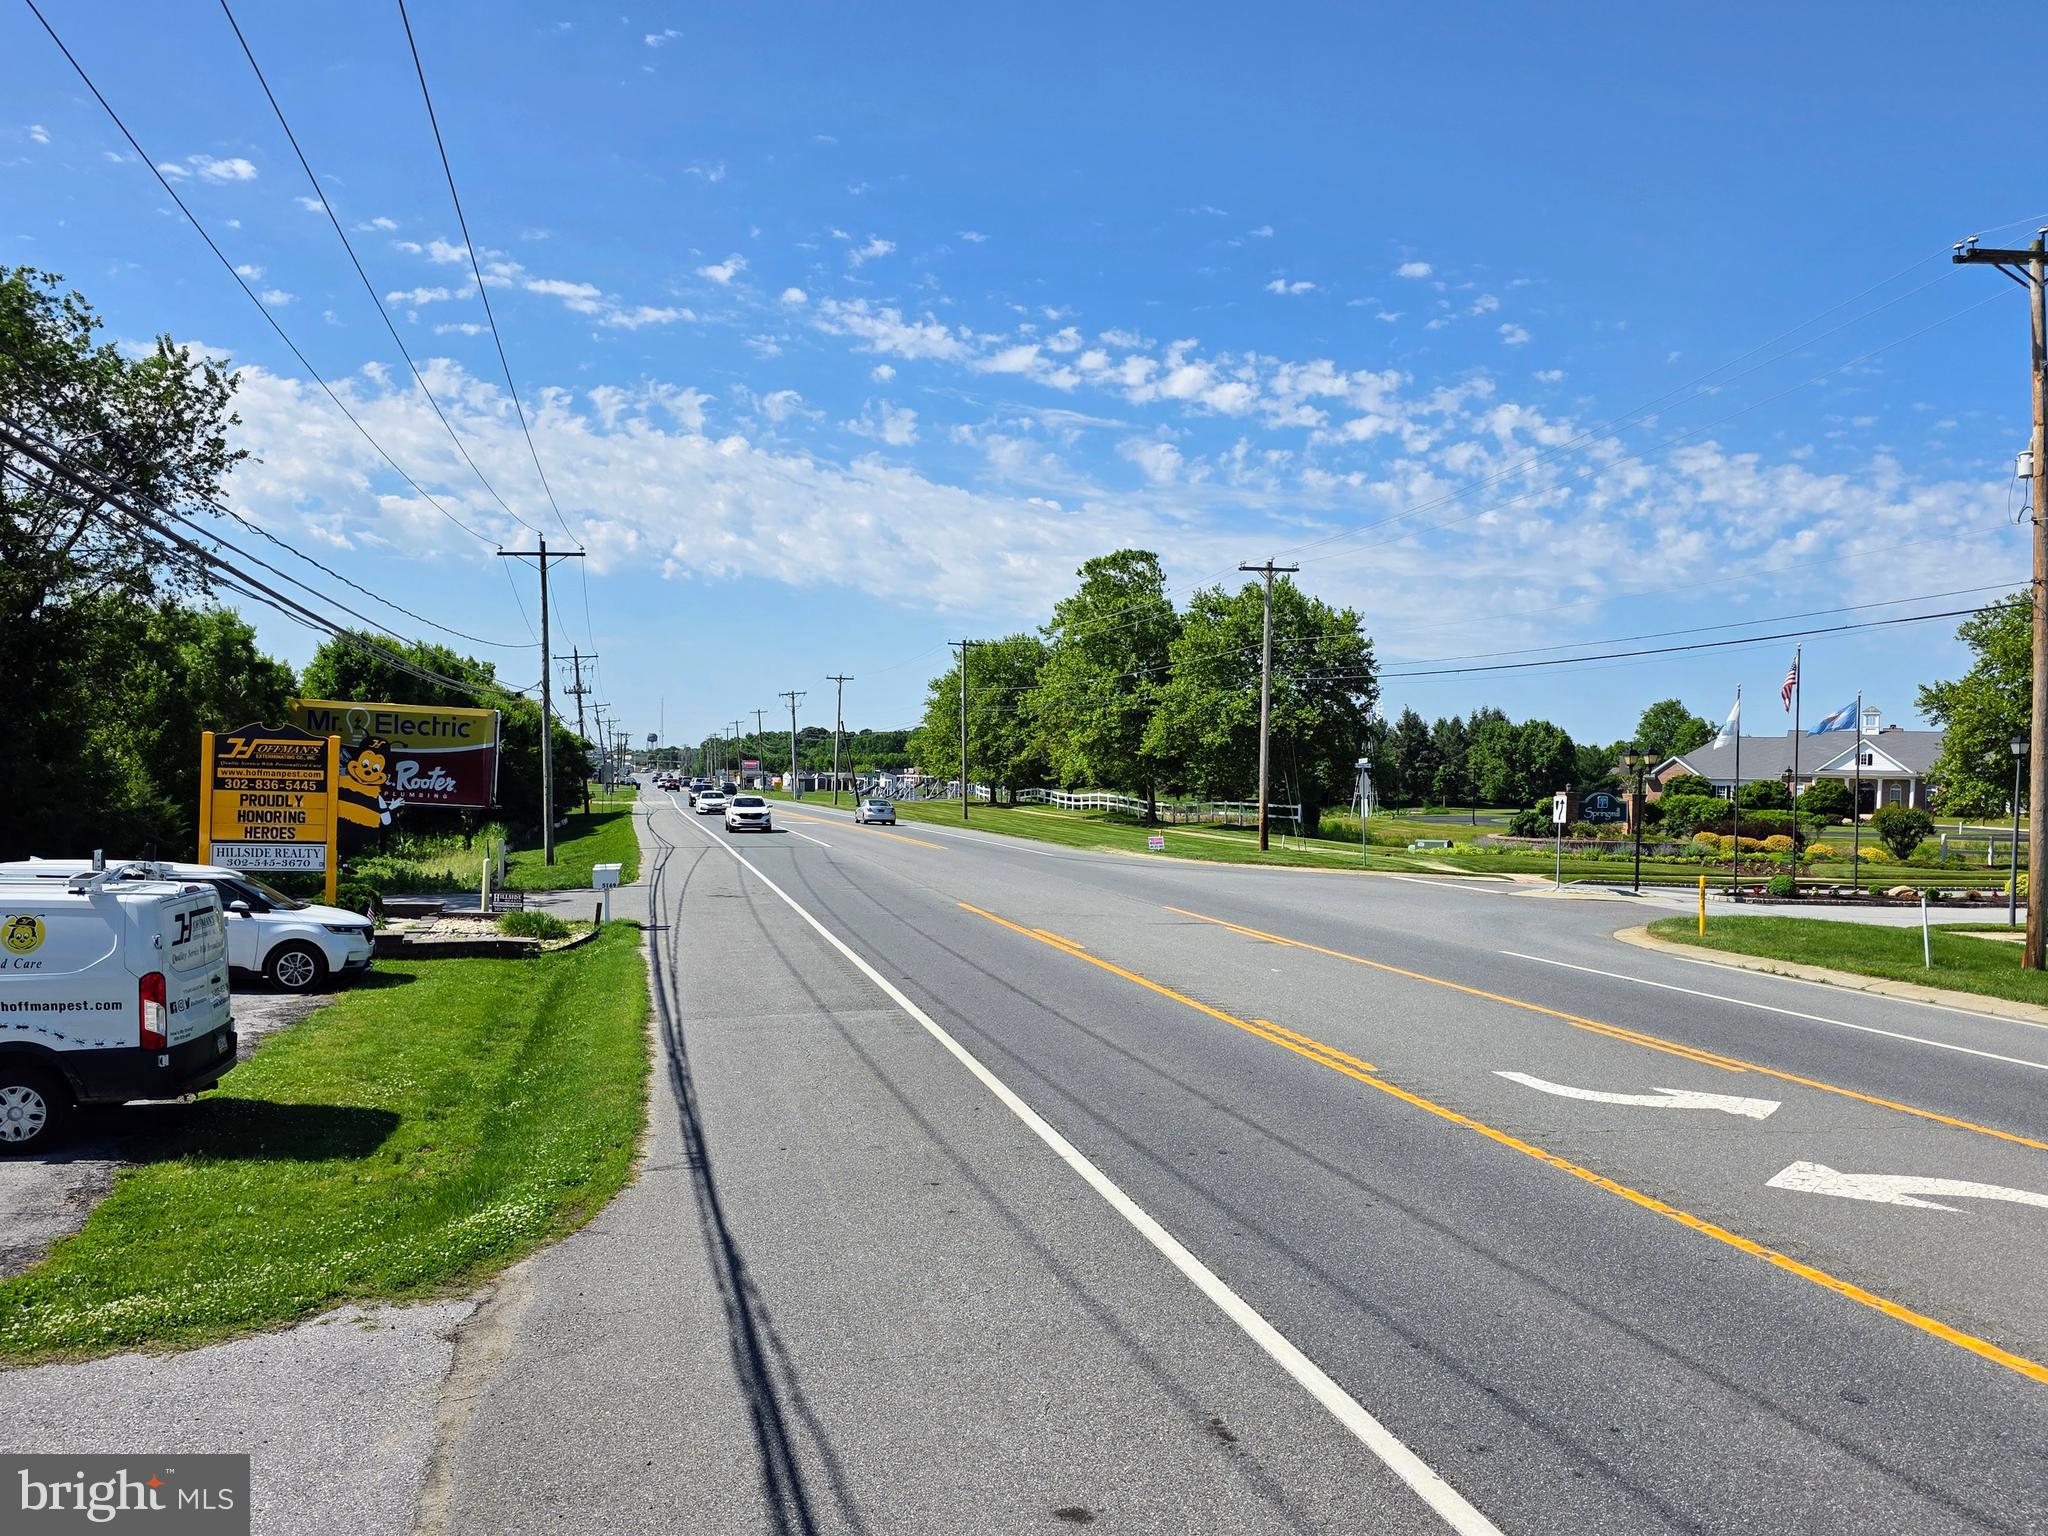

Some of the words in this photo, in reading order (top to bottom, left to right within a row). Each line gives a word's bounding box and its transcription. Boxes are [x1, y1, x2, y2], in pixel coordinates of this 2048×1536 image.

[307, 710, 343, 732] Mr.
[375, 712, 471, 738] Electric
[220, 768, 321, 778] www.hoffmanpest.com
[396, 760, 456, 792] Rooter
[225, 779, 317, 790] 302-836-5445
[240, 794, 304, 807] PROUDLY
[384, 791, 448, 799] PLUMBING
[237, 810, 306, 823] HONORING
[244, 826, 296, 839] HEROES
[216, 847, 271, 858] HILLSIDE
[275, 849, 321, 858] REALTY
[226, 859, 311, 867] 302-545-3670
[14, 957, 42, 969] Care
[0, 1000, 122, 1013] hoffmanpest.com
